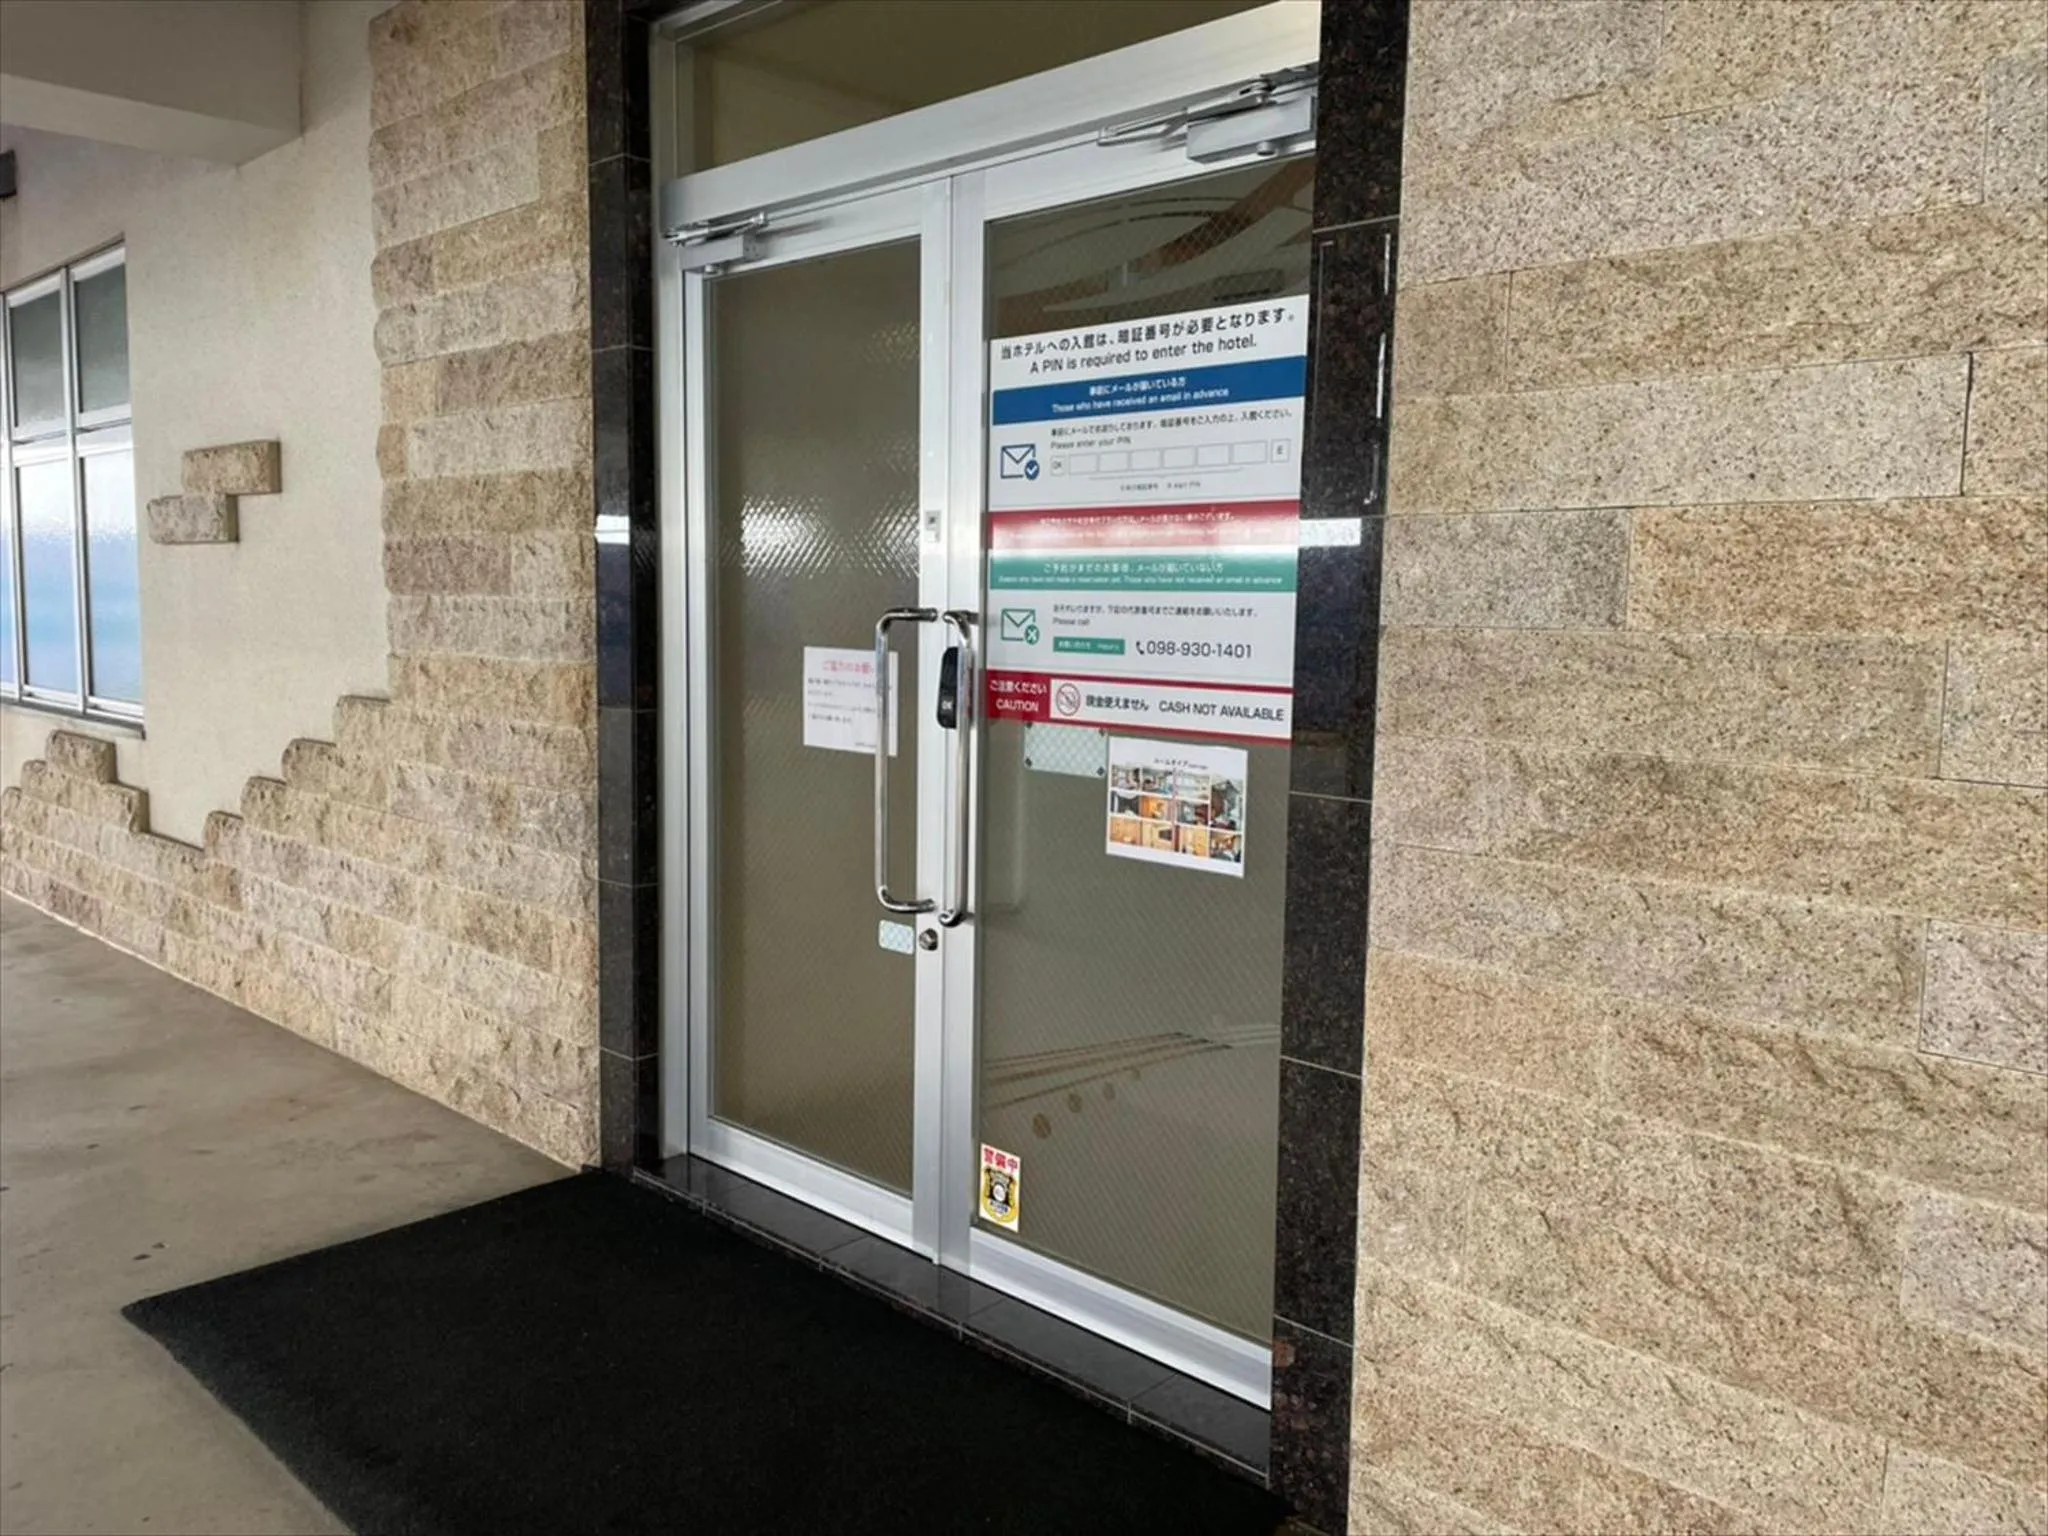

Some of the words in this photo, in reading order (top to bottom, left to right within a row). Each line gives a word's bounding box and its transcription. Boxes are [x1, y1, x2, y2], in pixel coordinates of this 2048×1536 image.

[1001, 306, 1295, 360] 当ホテルへの入館は、暗証番号が必要となります。
[1030, 361, 1039, 374] A
[1042, 358, 1063, 372] PIN
[1067, 356, 1077, 370] is
[1080, 350, 1131, 369] required
[1135, 349, 1149, 361] to
[1152, 342, 1187, 357] enter
[1192, 338, 1214, 354] the
[1218, 333, 1257, 351] hotel.
[1052, 403, 1074, 413] Those
[1076, 402, 1091, 411] who
[1093, 399, 1111, 409] have
[1113, 395, 1146, 407] received
[1148, 395, 1158, 404] an
[1160, 391, 1181, 403] email
[1183, 390, 1192, 401] in
[1193, 387, 1229, 400] advance
[1146, 640, 1252, 658] 098-930-1401
[989, 680, 1048, 695] ご注意ください
[996, 699, 1039, 712] CAUTION
[1085, 694, 1149, 711] 現金使えません
[1159, 700, 1191, 713] CASH
[1193, 703, 1217, 716] NOT
[1220, 705, 1285, 721] AVAILABLE
[984, 1147, 1018, 1173] 警備中
